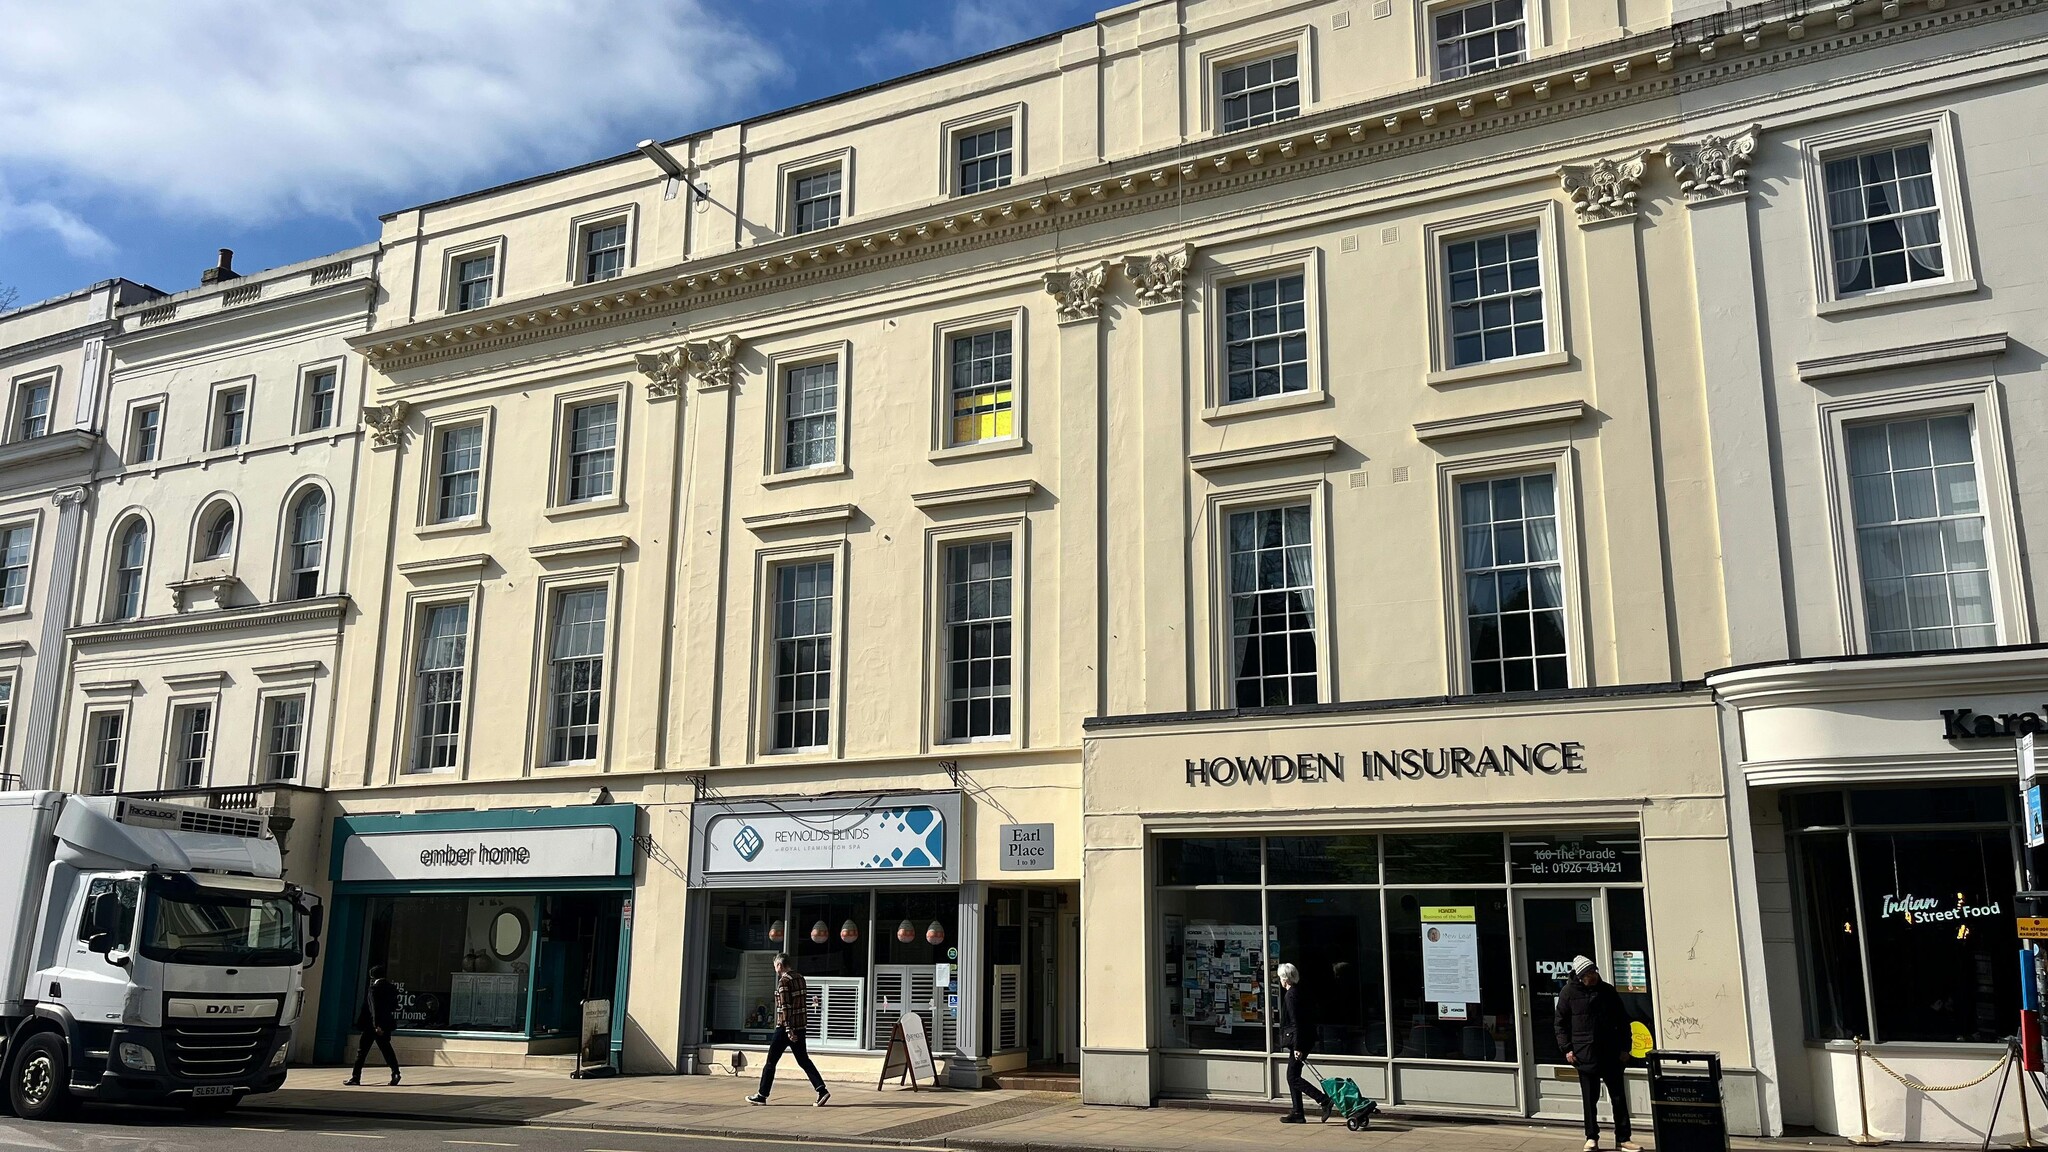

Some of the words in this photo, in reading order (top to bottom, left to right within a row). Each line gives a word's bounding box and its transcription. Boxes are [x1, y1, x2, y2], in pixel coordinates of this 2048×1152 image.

[1940, 704, 2048, 739] Kara
[1186, 752, 1342, 785] HOWDEN
[1362, 742, 1585, 779] INSURANCE
[129, 804, 176, 819] FRIGOBLOCK
[775, 830, 830, 842] REYNOLDS
[833, 828, 869, 841] BLINDS
[1012, 829, 1041, 841] Earl
[420, 844, 475, 866] ember
[479, 843, 529, 864] home
[1009, 844, 1045, 856] Place
[1534, 850, 1552, 860] 160
[1556, 849, 1575, 859] The
[1579, 848, 1616, 859] Parade
[1531, 862, 1548, 873] Tel:
[1552, 863, 1582, 873] 01926
[1586, 862, 1622, 873] 431421
[1882, 894, 1939, 918] Indian
[1914, 908, 1960, 923] Street
[1962, 902, 2001, 918] Food
[206, 1005, 245, 1014] DAF
[402, 1009, 427, 1020] home
[195, 1087, 216, 1096] SL69
[216, 1085, 231, 1094] LXS
